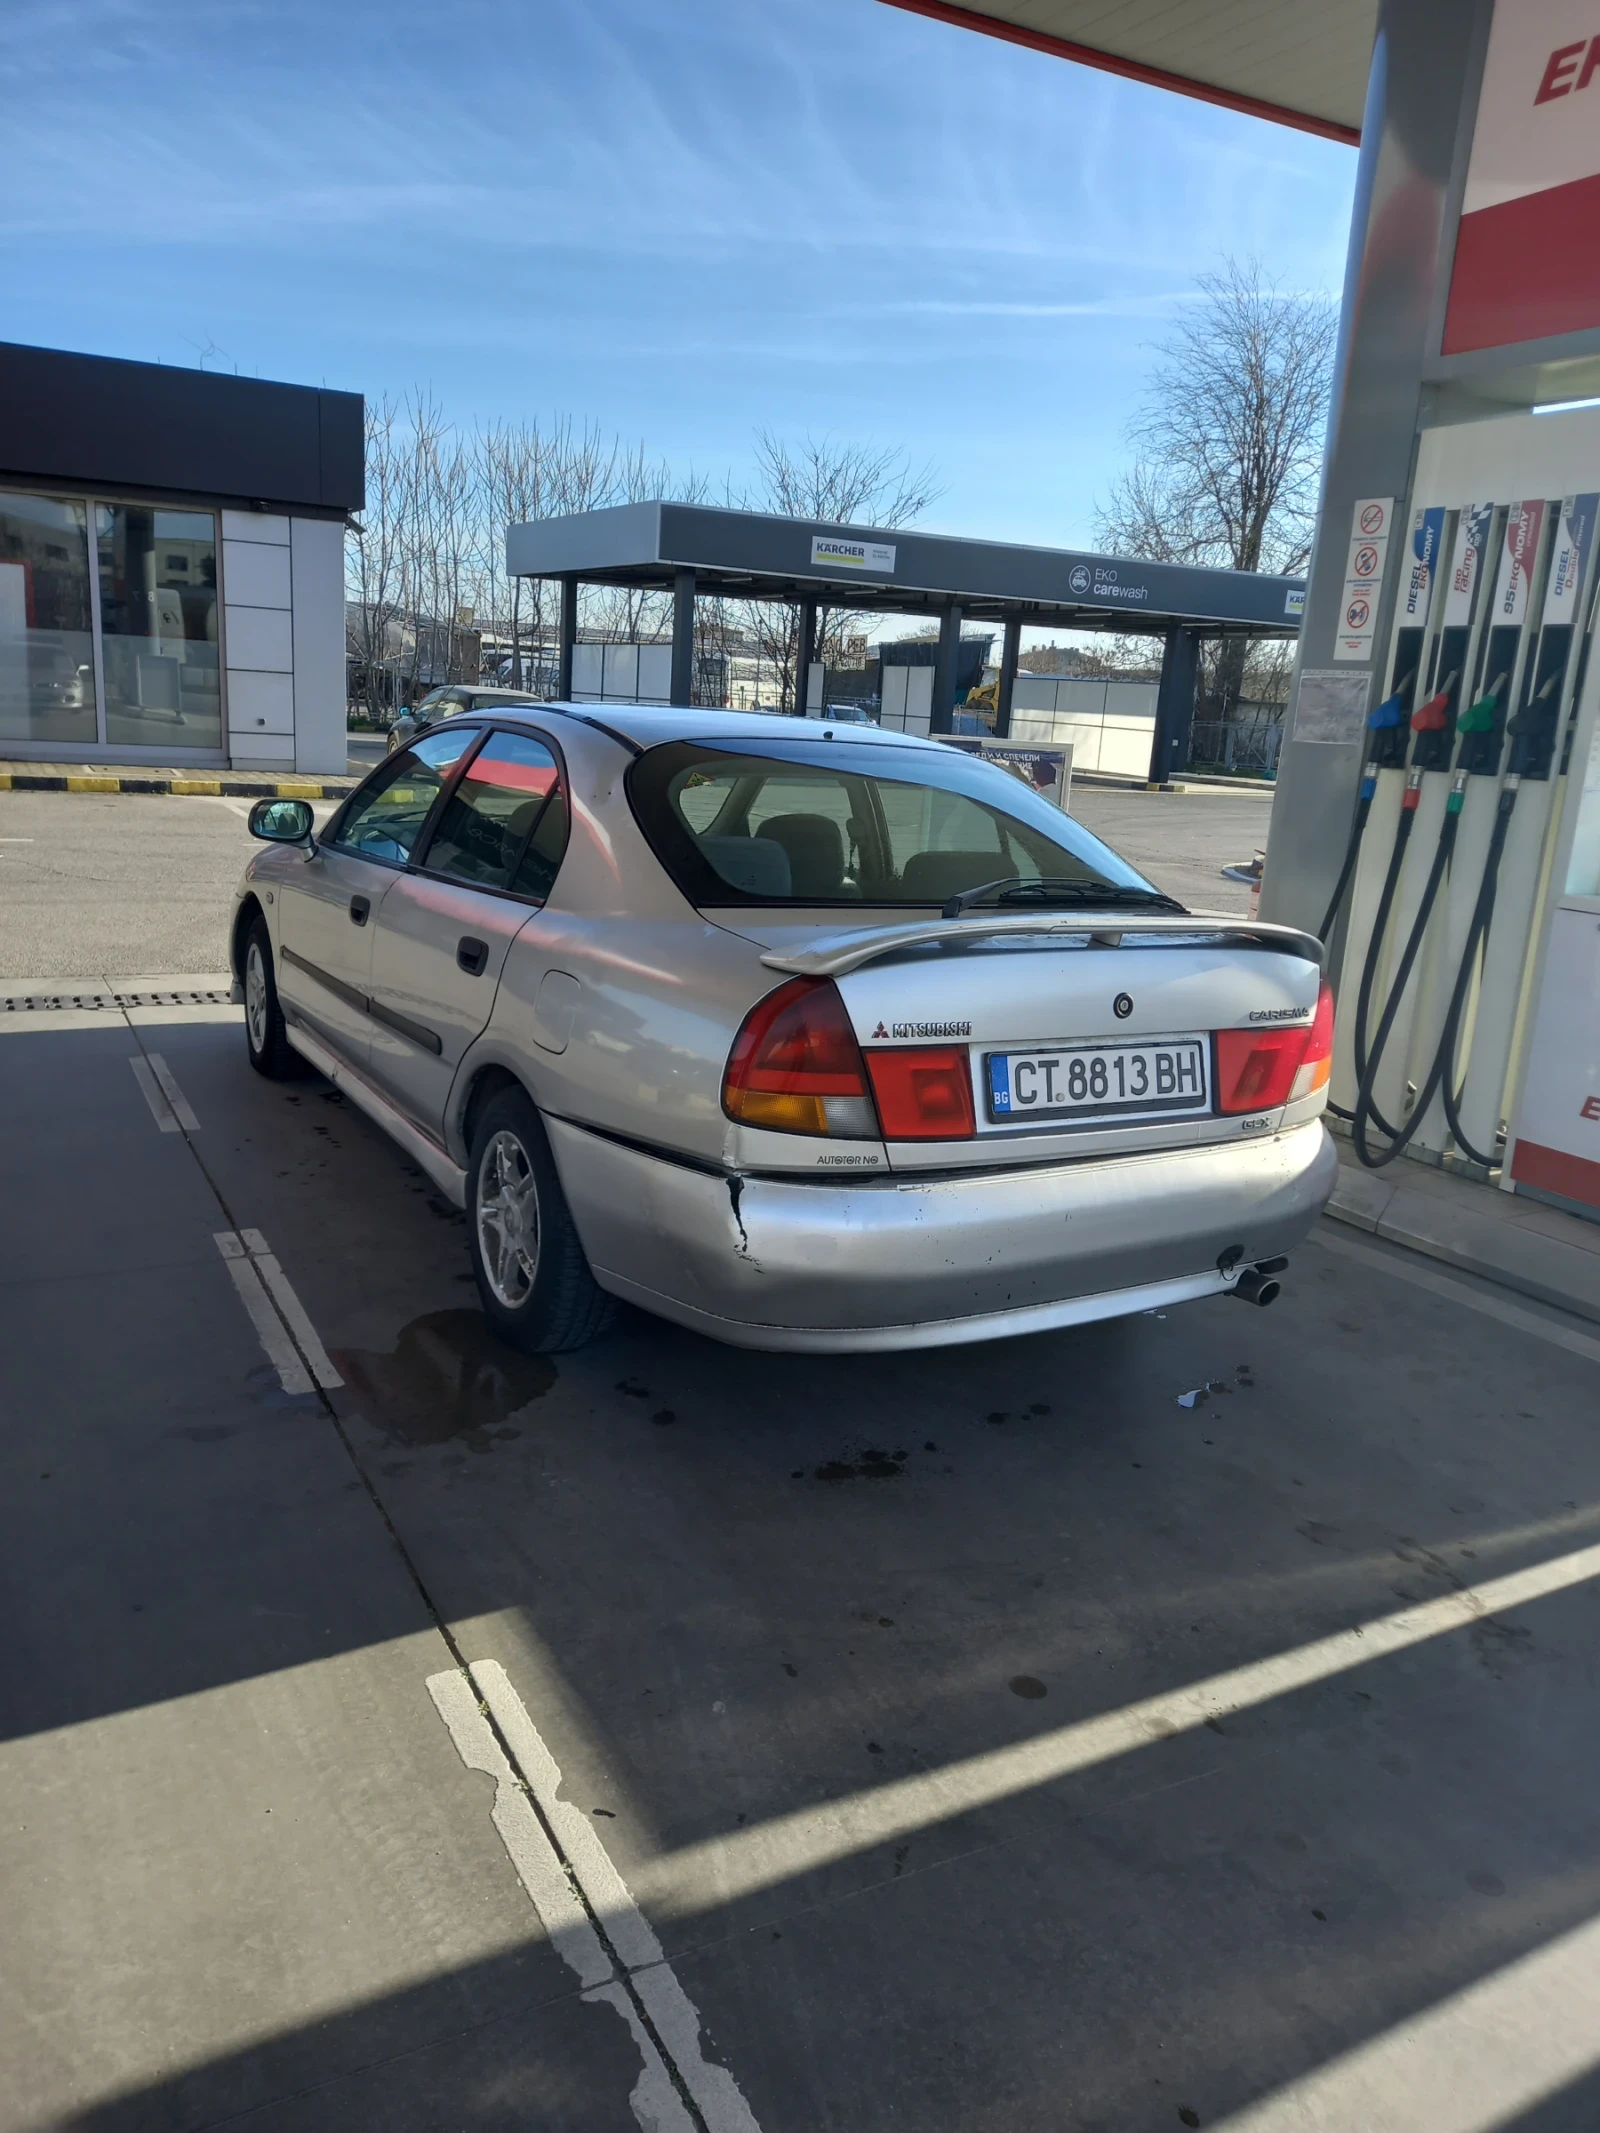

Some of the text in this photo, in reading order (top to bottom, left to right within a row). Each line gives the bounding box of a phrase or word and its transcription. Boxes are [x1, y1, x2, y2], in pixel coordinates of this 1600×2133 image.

[816, 542, 865, 557] KÄRCHER
[1418, 525, 1435, 590] EKONOMY
[1095, 568, 1118, 582] EKO
[1460, 547, 1475, 593] racing
[1554, 548, 1570, 597] DIESEL
[1565, 549, 1579, 589] Double
[1406, 561, 1423, 614] DIESEL
[1454, 568, 1462, 592] EKO
[1093, 583, 1148, 600] carewash
[1003, 752, 1040, 762] СПЕЧЕЛИ
[1248, 1007, 1310, 1021] CARISMA
[892, 1021, 973, 1038] MITSUBISHI
[1014, 1051, 1198, 1105] CT 8813 BH
[994, 1091, 1009, 1105] BG
